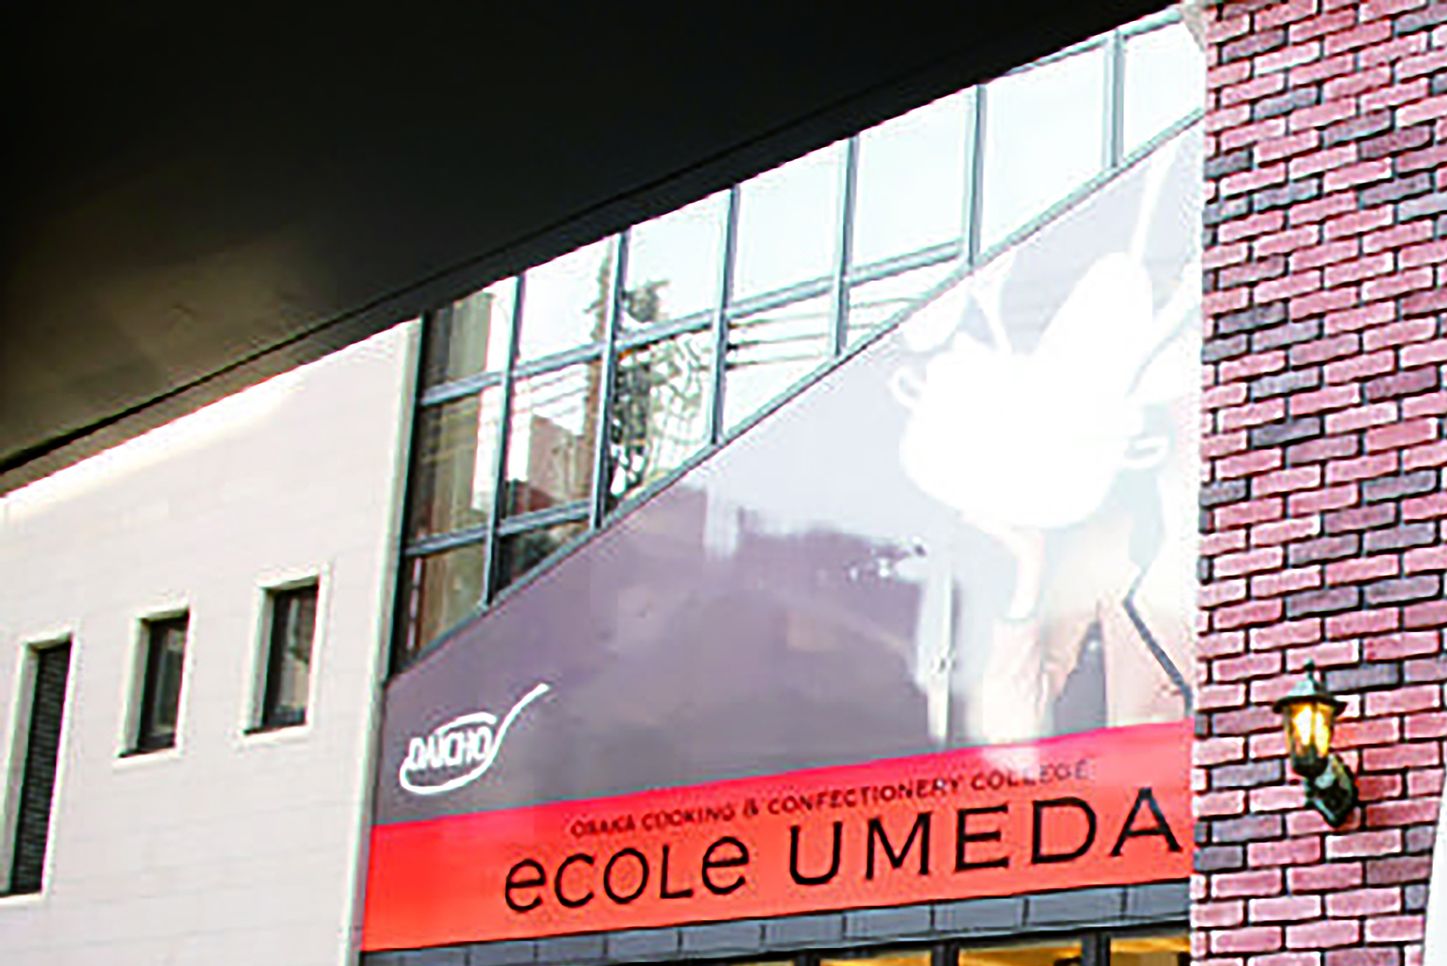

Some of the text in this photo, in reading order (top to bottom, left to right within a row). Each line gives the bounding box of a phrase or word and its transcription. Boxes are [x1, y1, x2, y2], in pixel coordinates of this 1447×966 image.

[570, 814, 636, 838] OSAKA
[641, 808, 735, 831] COOKING
[768, 775, 962, 815] CONFECTIONERY
[970, 759, 1088, 791] COLLEGE
[788, 788, 1182, 885] UMEDA
